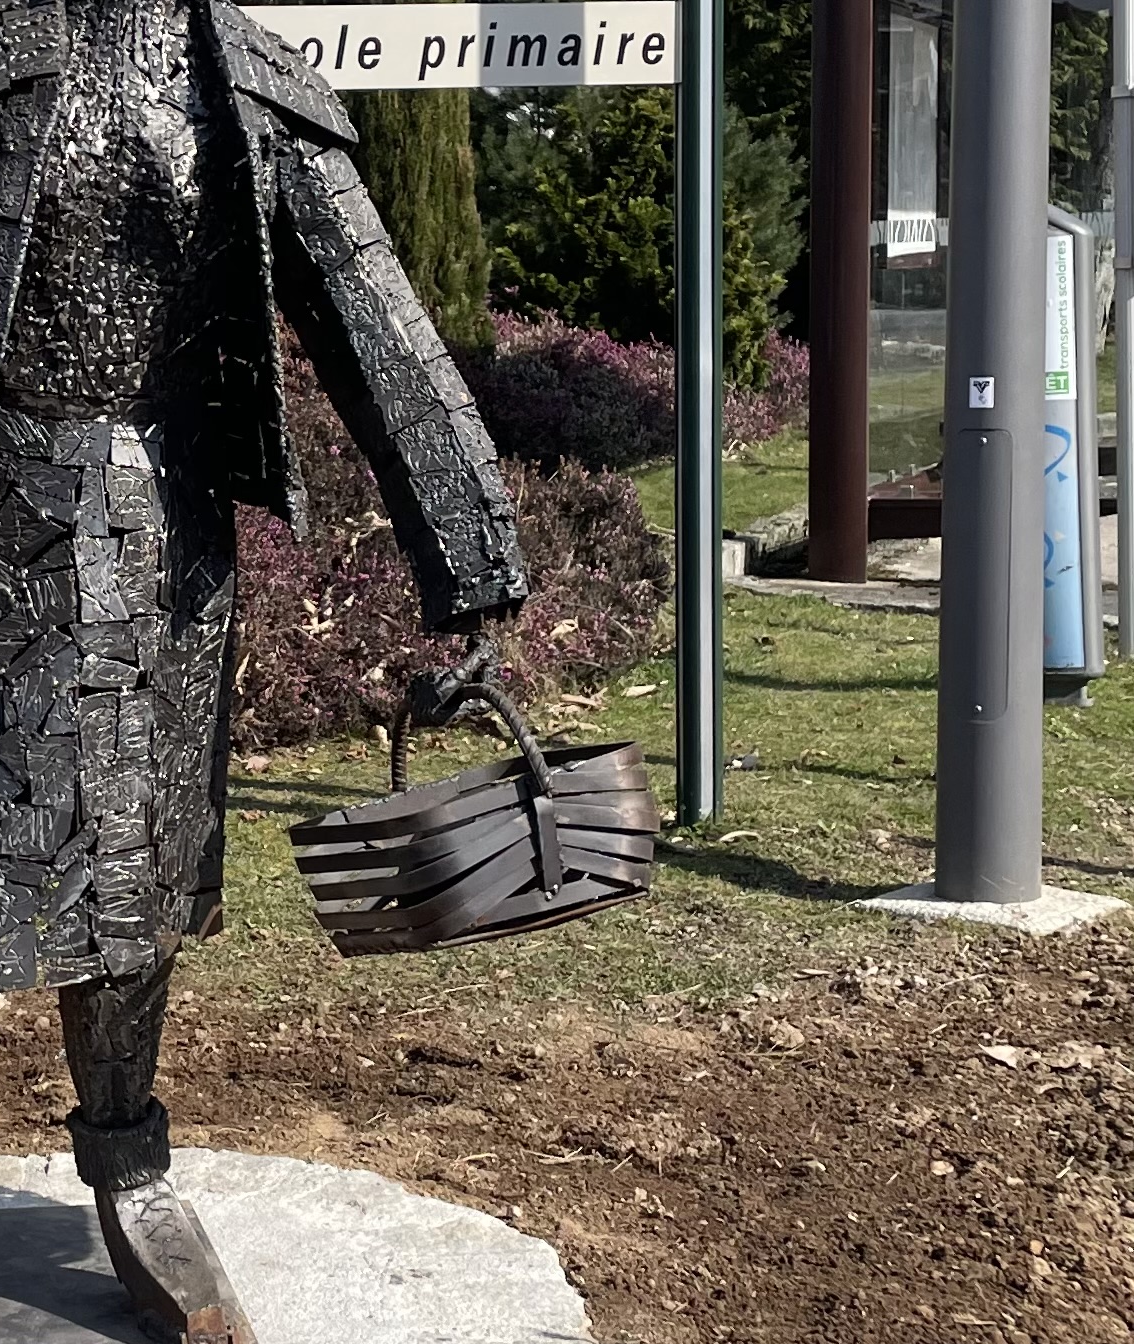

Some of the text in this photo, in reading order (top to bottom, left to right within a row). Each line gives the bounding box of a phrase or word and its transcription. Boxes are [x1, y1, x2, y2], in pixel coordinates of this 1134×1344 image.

[300, 20, 666, 82] ole primaire
[1056, 240, 1069, 370] transports scolaires
